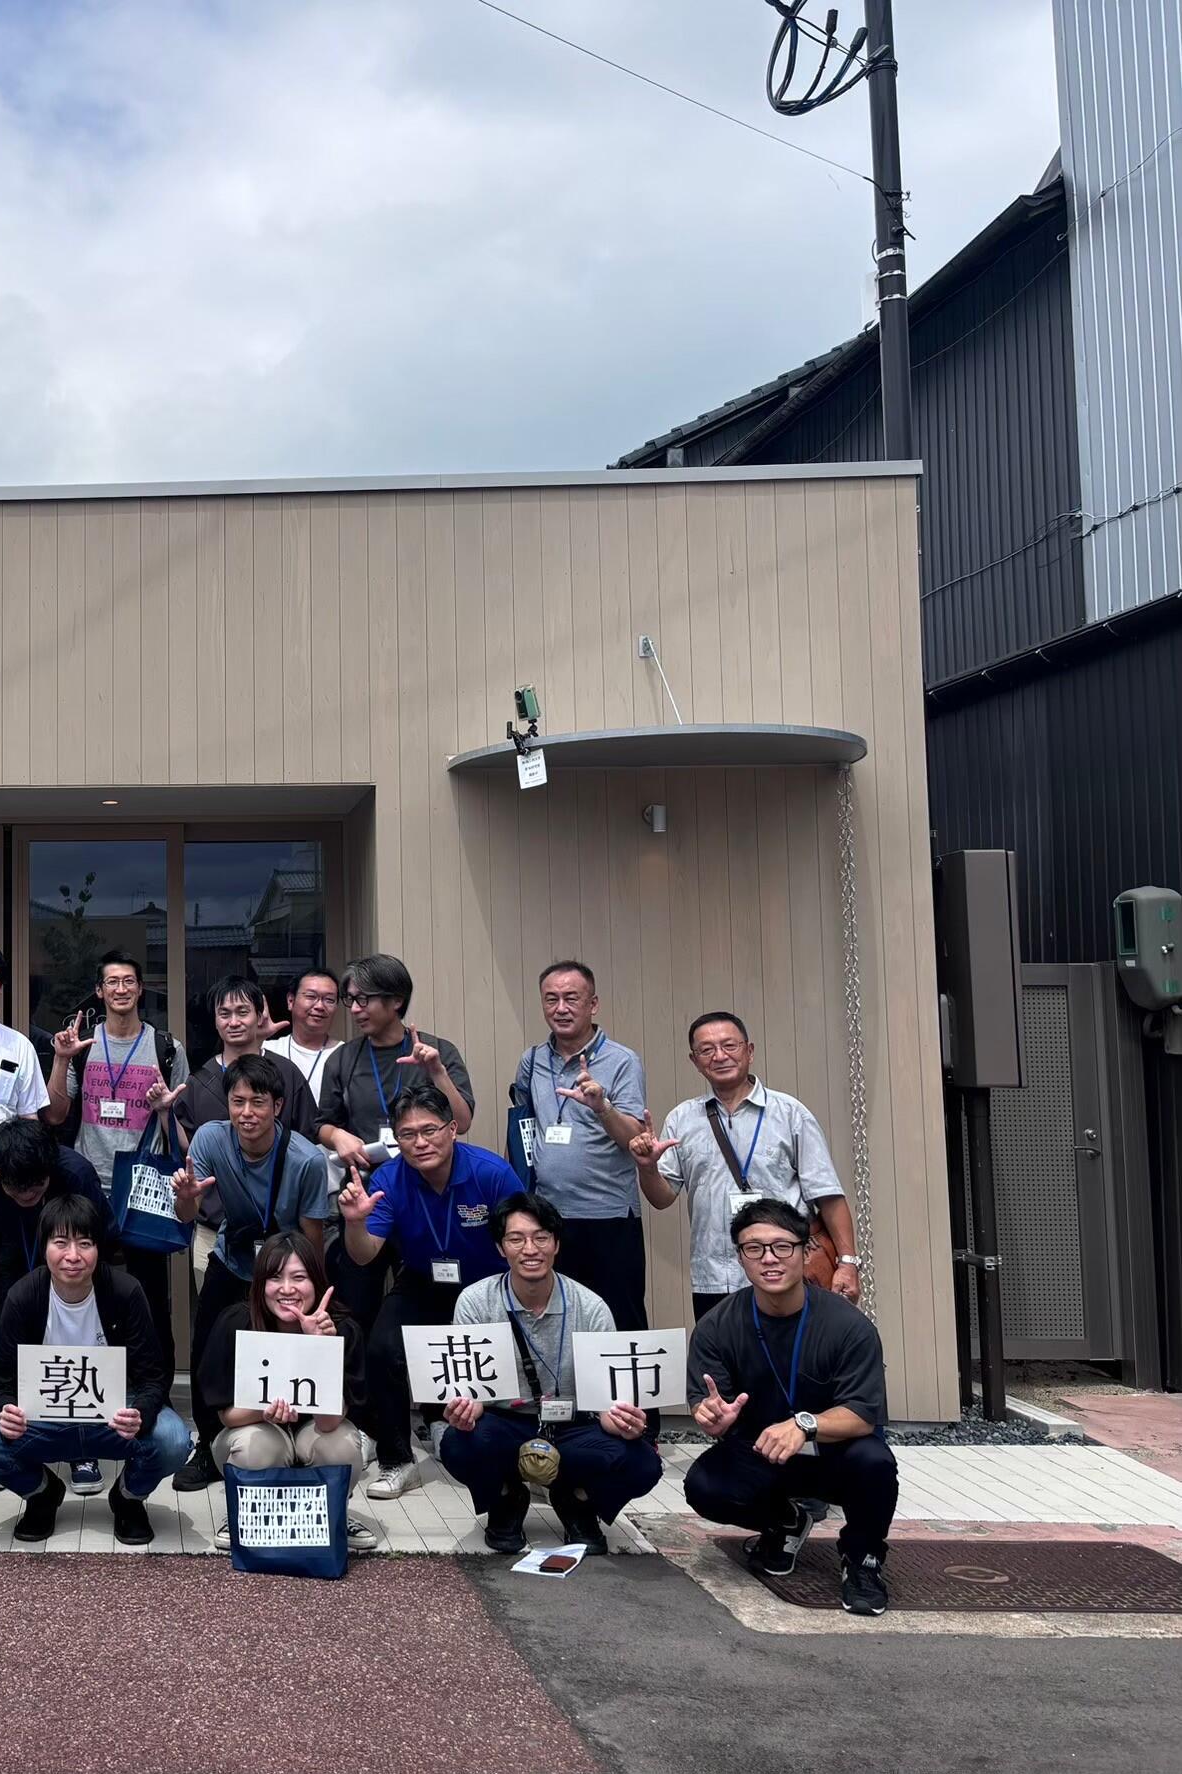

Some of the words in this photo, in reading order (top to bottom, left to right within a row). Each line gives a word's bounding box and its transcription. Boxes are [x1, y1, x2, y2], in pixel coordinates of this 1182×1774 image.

[91, 1078, 143, 1091] EURBEAT
[96, 1114, 132, 1128] NIGHT
[39, 1355, 106, 1421] 塾
[258, 1359, 319, 1407] in
[427, 1335, 498, 1401] 燕
[600, 1342, 667, 1408] 市
